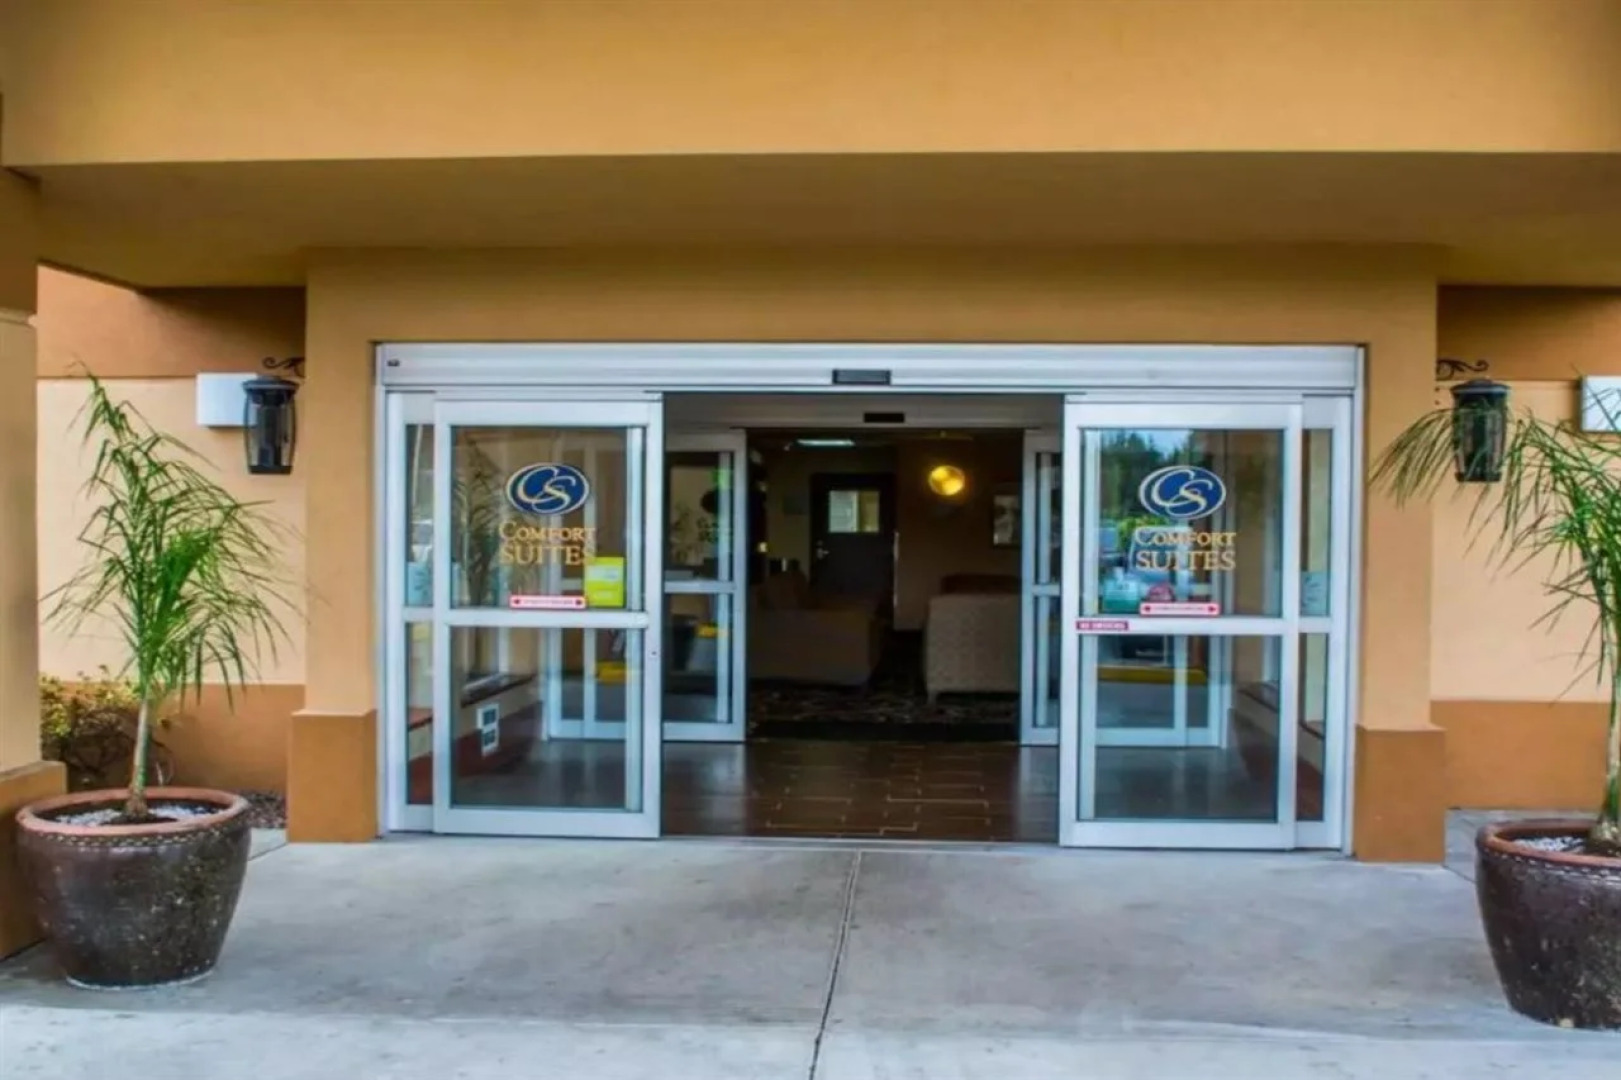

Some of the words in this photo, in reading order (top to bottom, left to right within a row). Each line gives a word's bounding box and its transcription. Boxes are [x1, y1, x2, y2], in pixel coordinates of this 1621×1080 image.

[500, 521, 596, 541] COMFORT
[1135, 528, 1236, 546] COMFORT
[500, 543, 597, 565] SUITES
[1135, 550, 1236, 571] SUITES
